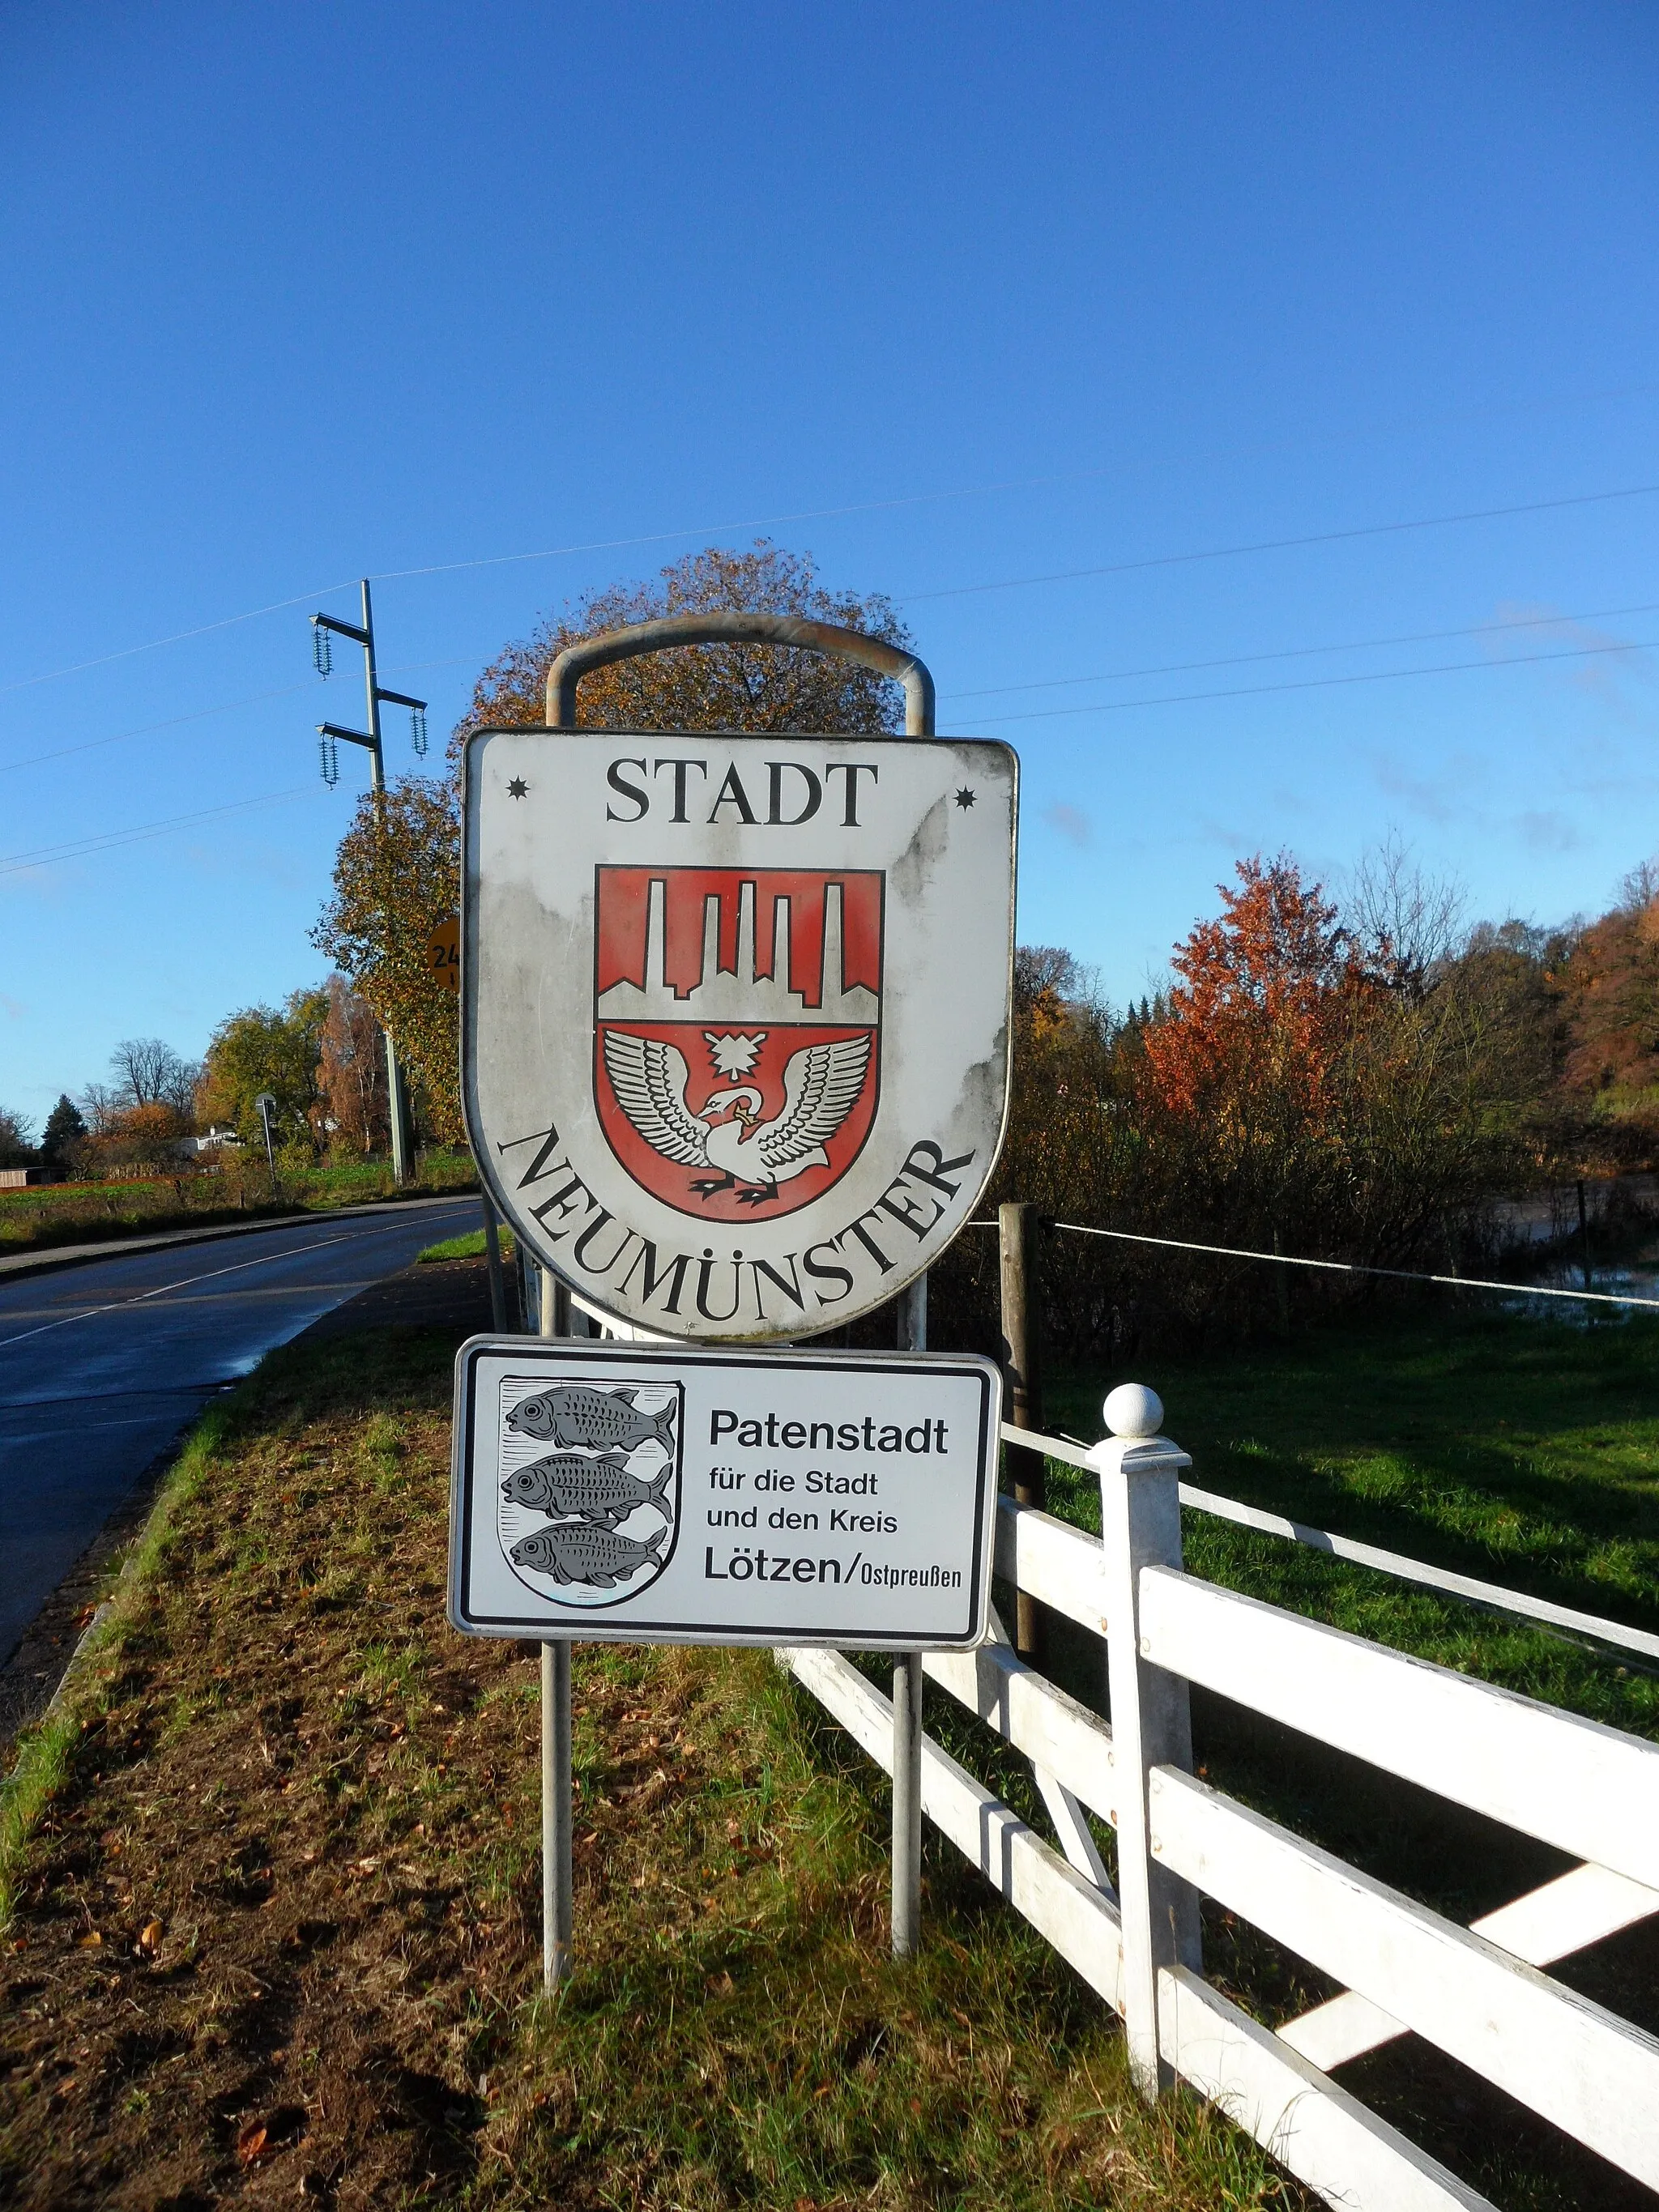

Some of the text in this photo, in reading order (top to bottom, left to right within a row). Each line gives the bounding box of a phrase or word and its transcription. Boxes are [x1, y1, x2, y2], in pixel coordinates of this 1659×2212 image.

[606, 757, 879, 827] STADT
[497, 1123, 975, 1321] NEUMÜNSTER
[710, 1409, 949, 1455] Patenstadt
[709, 1467, 878, 1495] für die Stadt
[707, 1506, 898, 1533] und den Kreis
